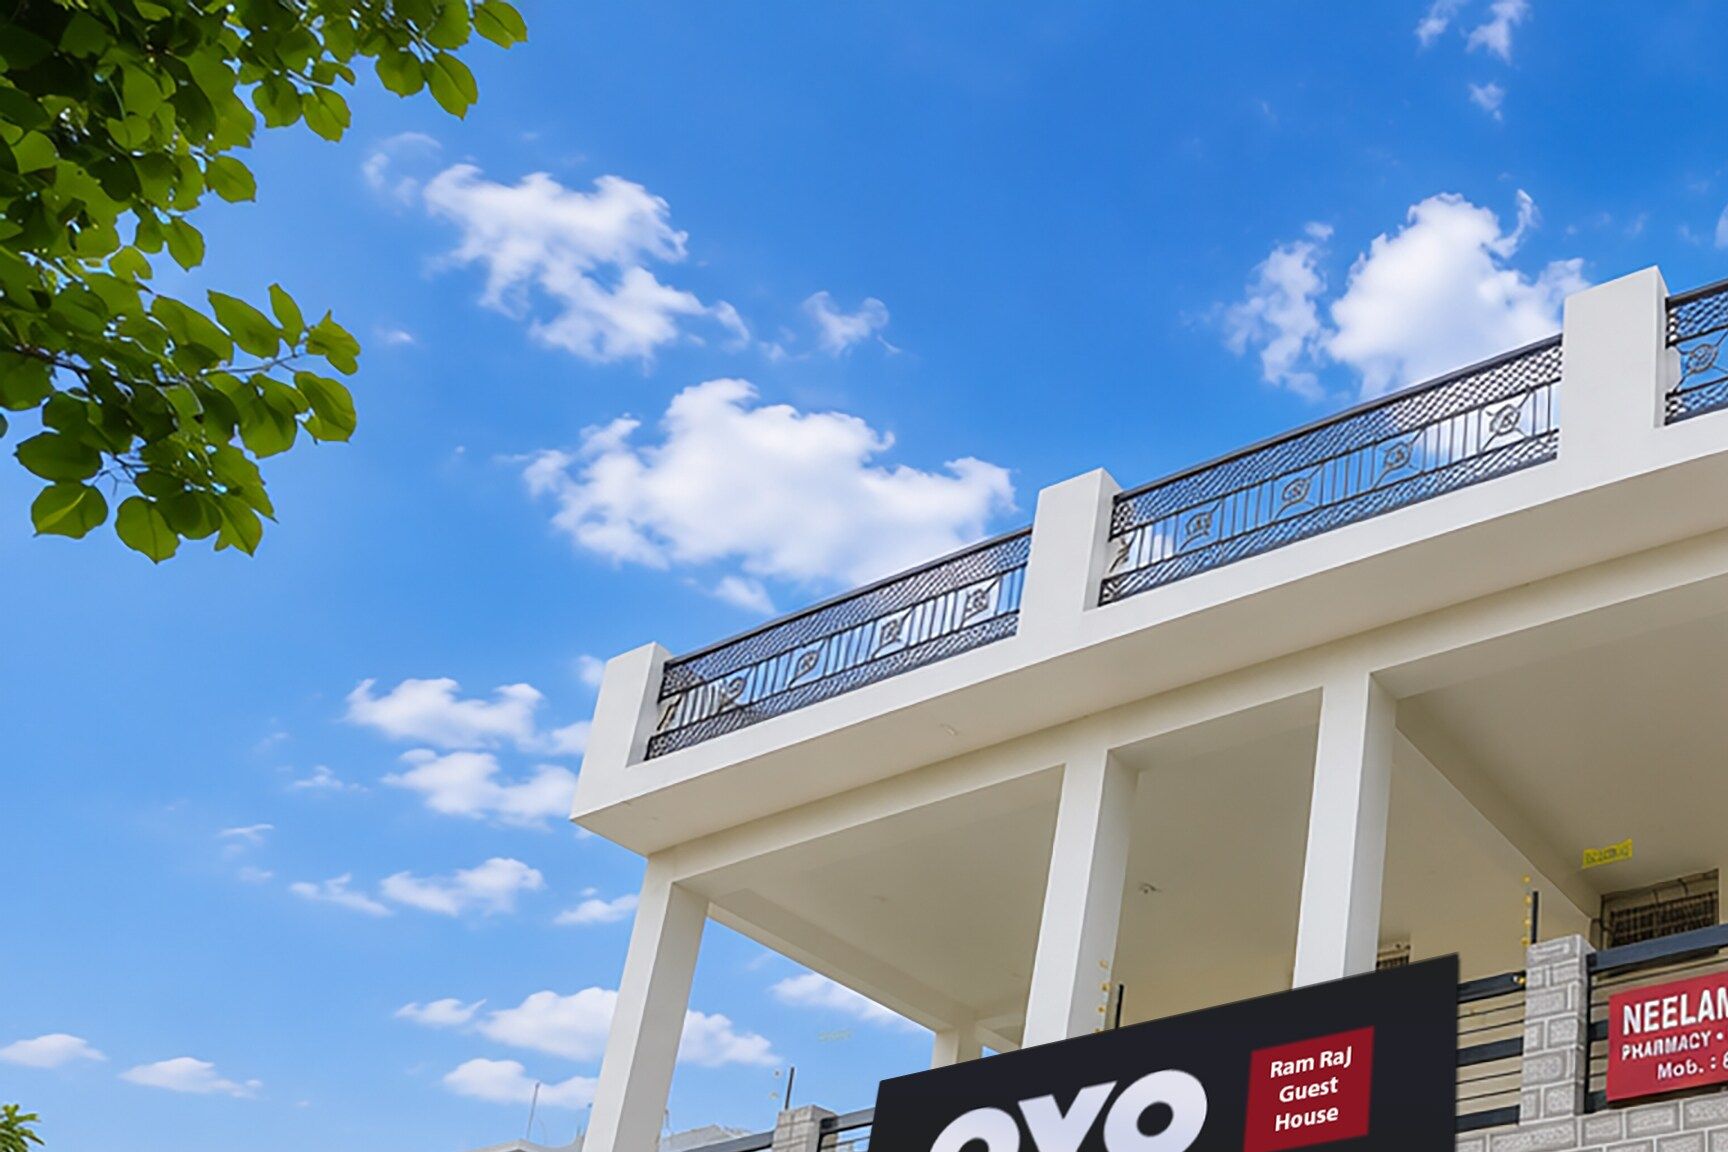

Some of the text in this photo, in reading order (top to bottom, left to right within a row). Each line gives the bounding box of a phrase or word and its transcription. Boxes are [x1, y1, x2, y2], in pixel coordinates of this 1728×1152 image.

[1621, 1031, 1711, 1061] PHARMACY
[1270, 1057, 1315, 1079] Ram
[1279, 1076, 1339, 1103] Guest
[1275, 1106, 1339, 1132] House
